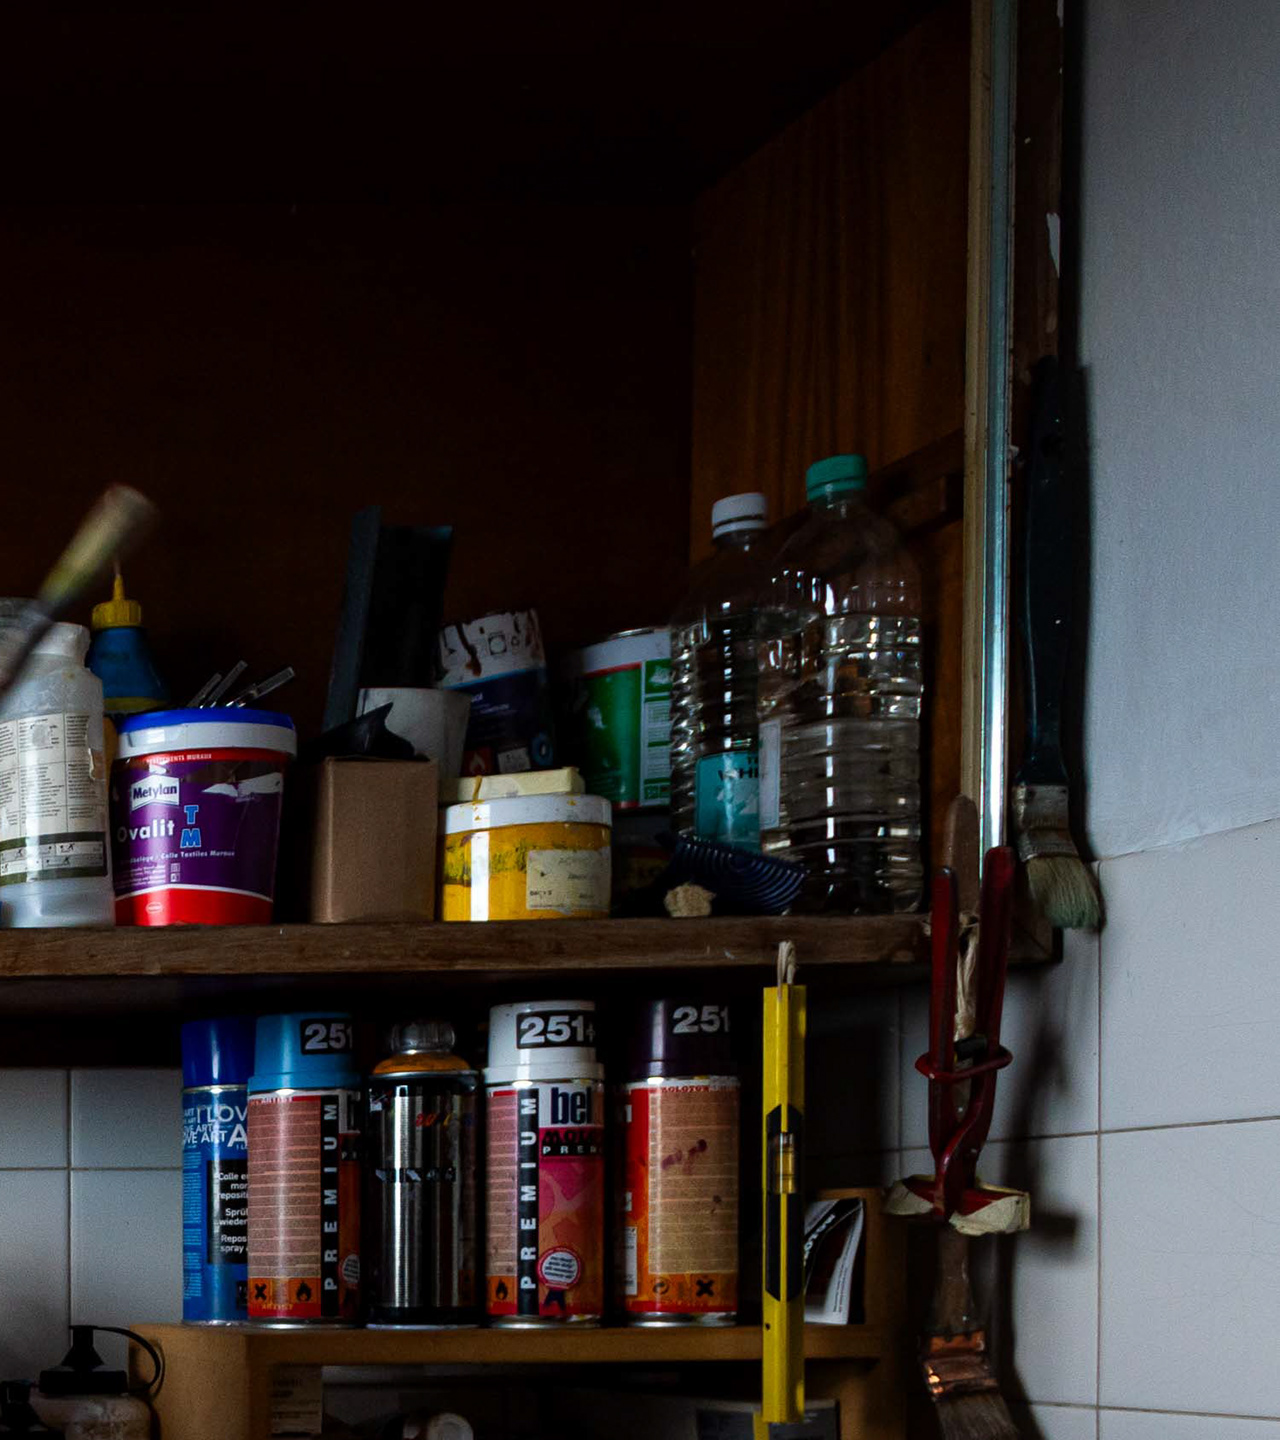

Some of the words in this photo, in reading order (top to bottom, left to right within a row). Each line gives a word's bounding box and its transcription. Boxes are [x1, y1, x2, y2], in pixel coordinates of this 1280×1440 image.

[133, 784, 177, 801] Metylan
[184, 804, 199, 825] T
[116, 819, 176, 843] Ovalit
[180, 827, 202, 849] M
[206, 1105, 248, 1123] LOV
[551, 1087, 592, 1125] bel
[201, 1130, 228, 1143] ART
[323, 1104, 338, 1290] PREMIUM
[521, 1098, 536, 1290] PREMIUM
[220, 1245, 244, 1255] spray
